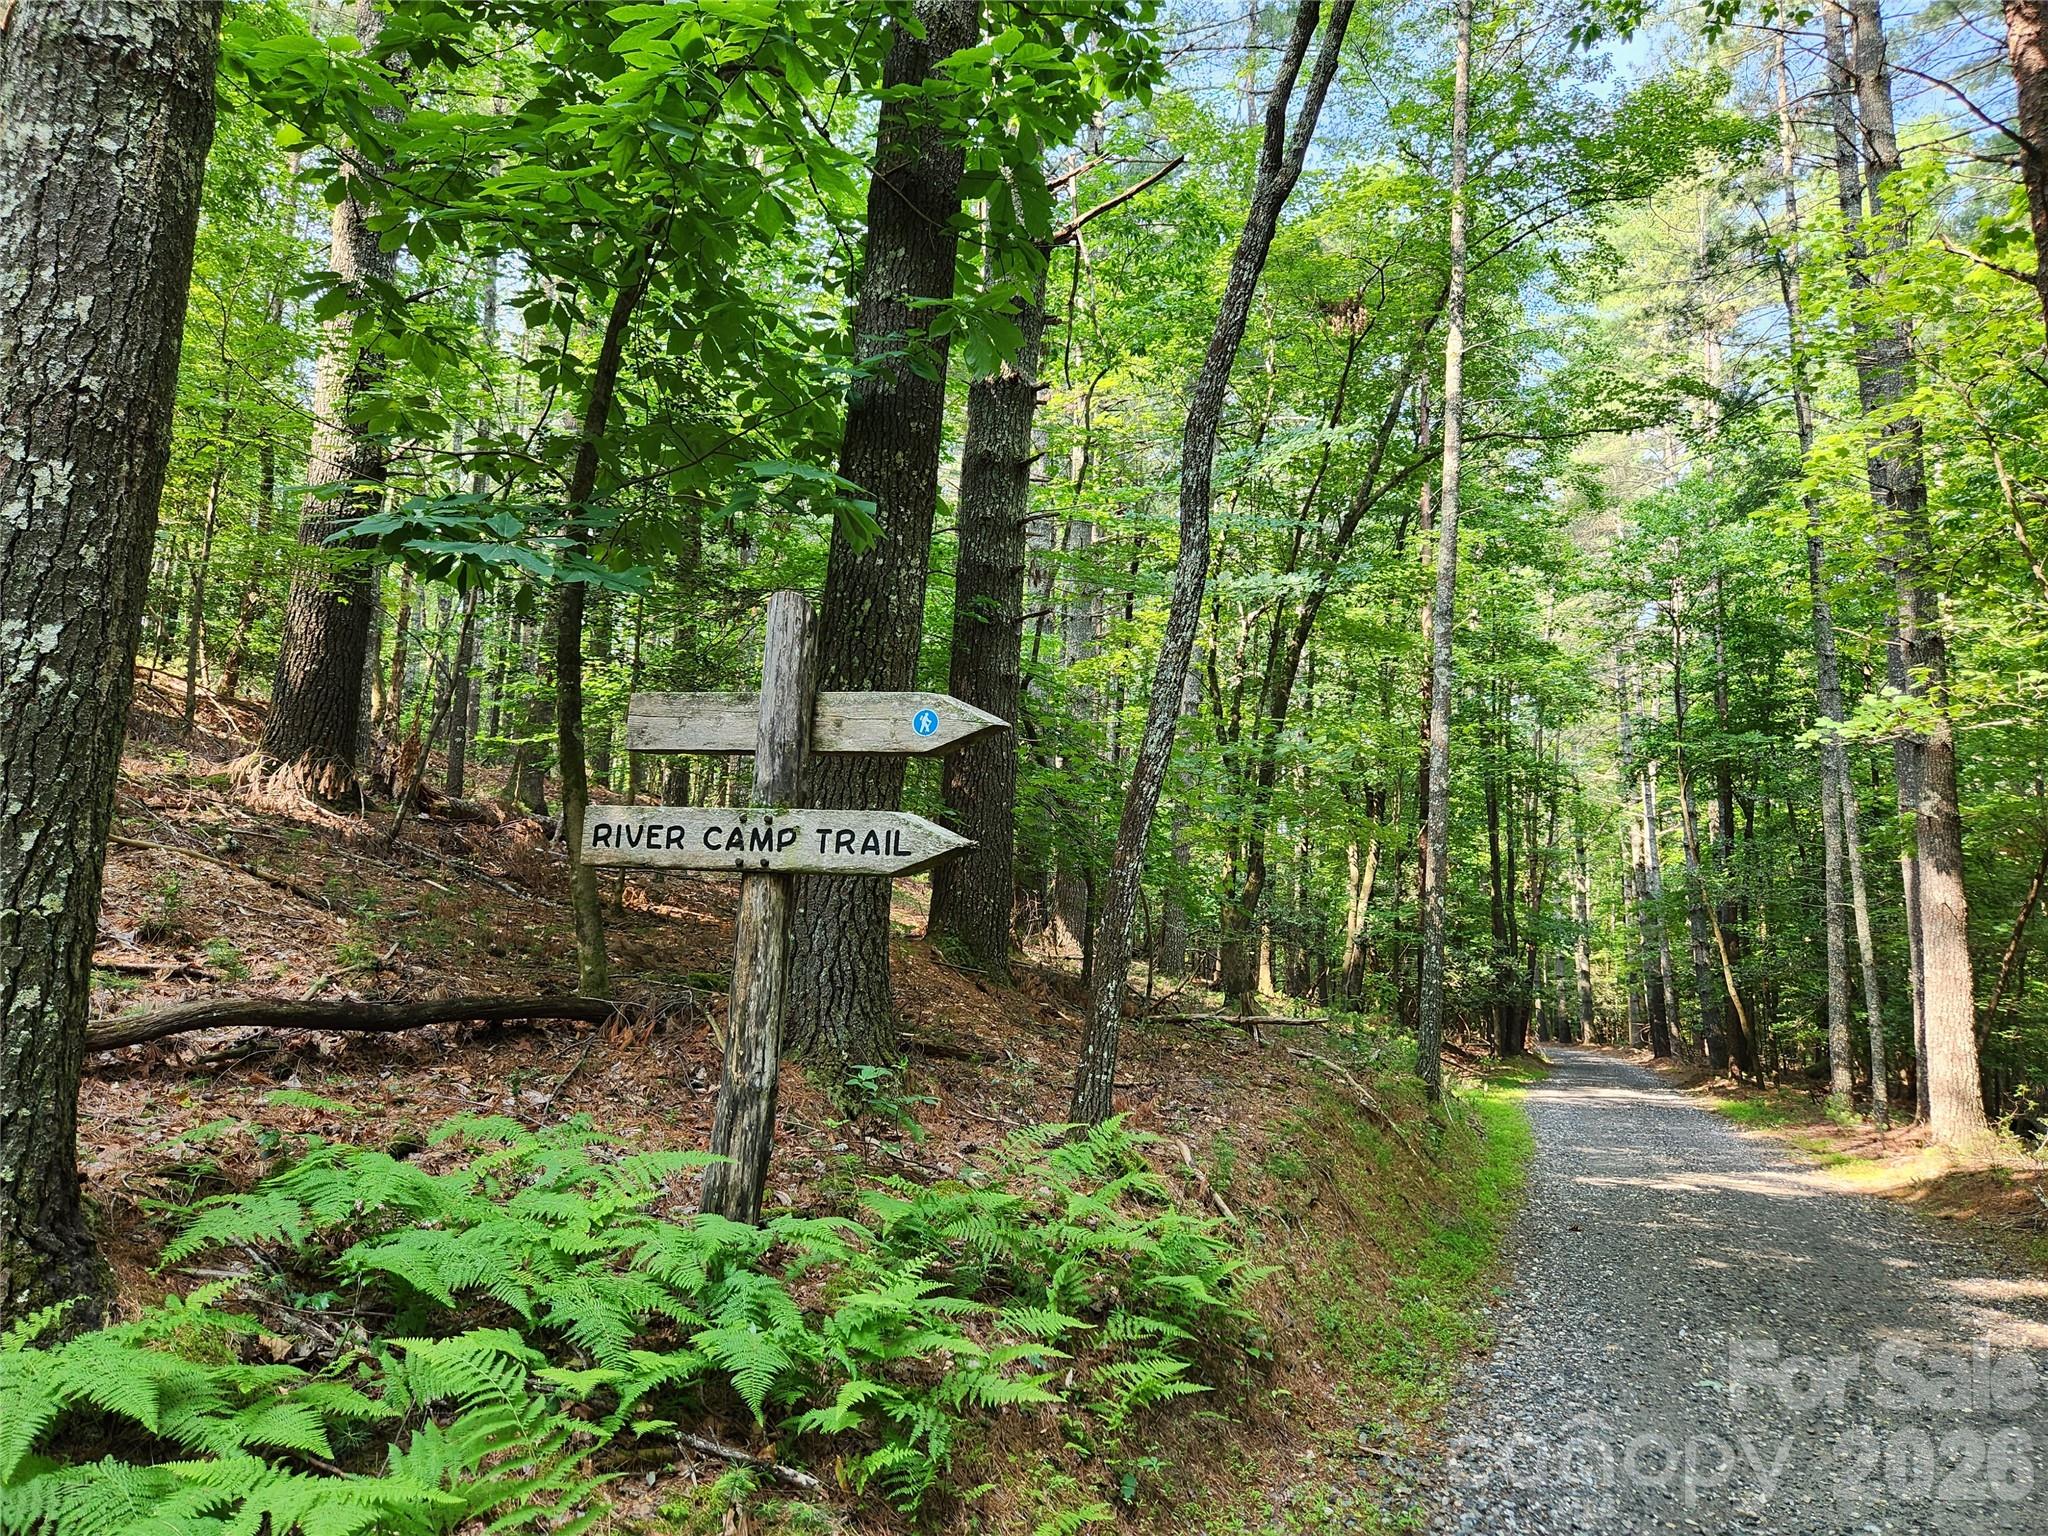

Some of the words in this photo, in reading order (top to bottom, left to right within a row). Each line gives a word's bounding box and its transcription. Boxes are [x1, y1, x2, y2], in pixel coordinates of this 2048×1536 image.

[592, 822, 685, 850] RIVER
[703, 825, 797, 853] CAMP
[815, 827, 912, 857] TRAIL
